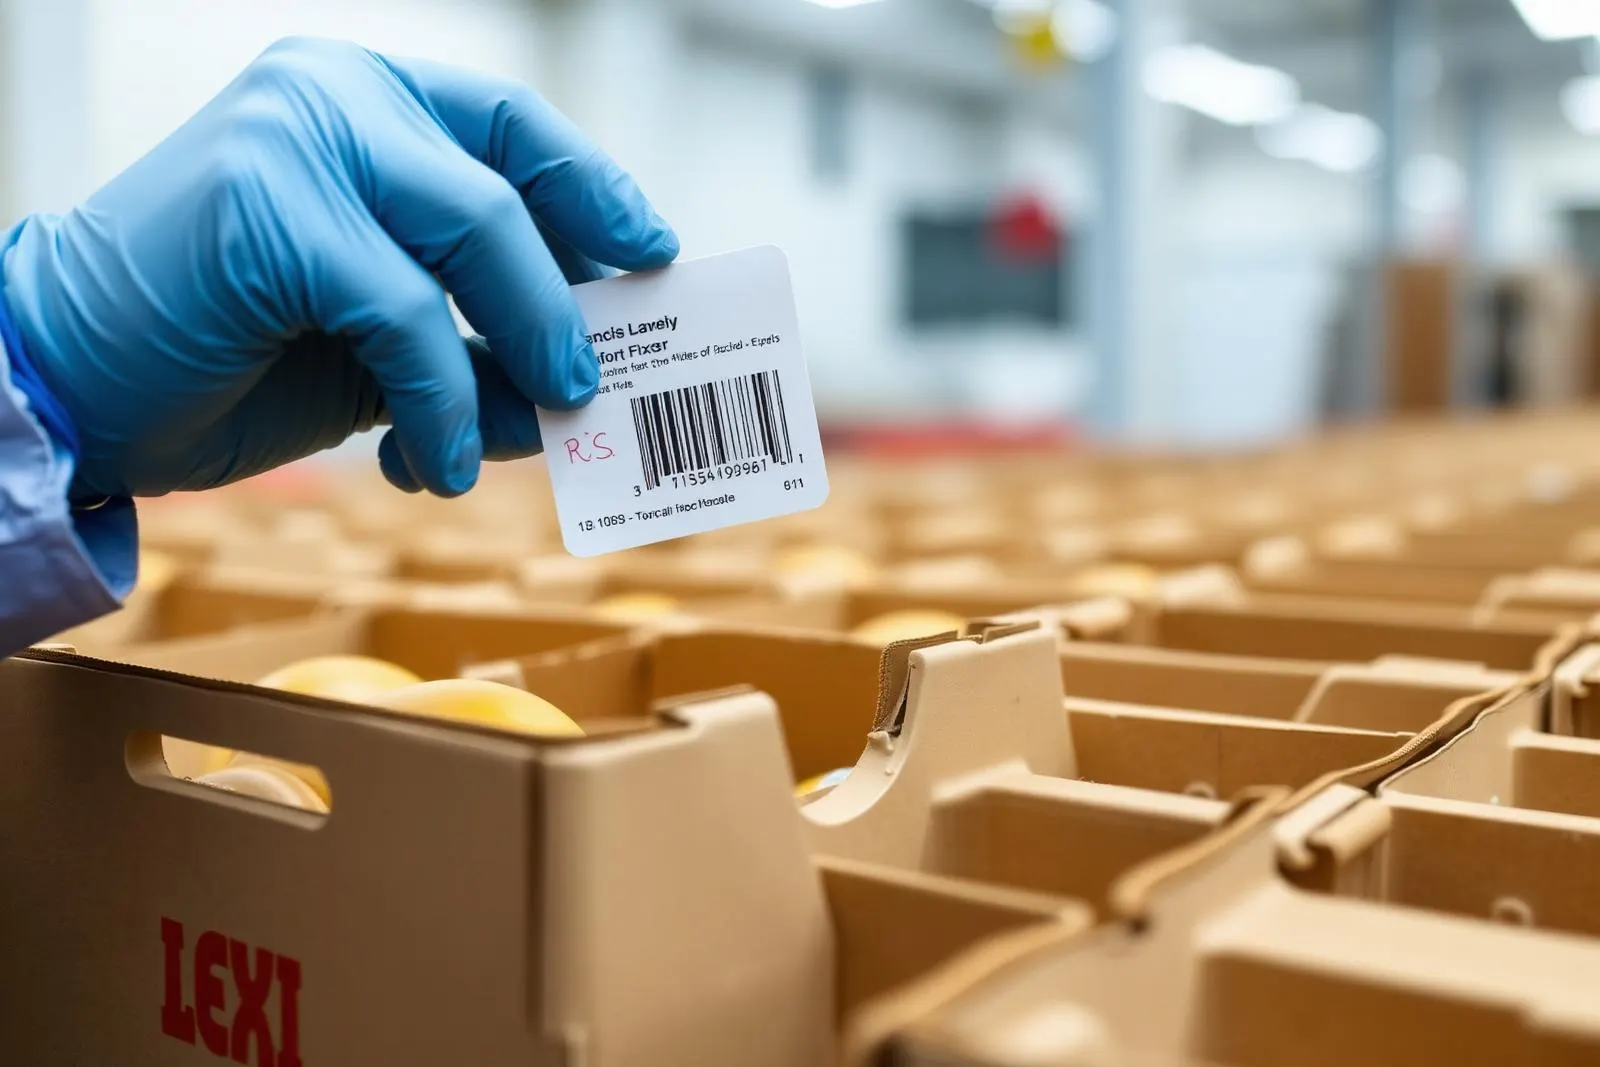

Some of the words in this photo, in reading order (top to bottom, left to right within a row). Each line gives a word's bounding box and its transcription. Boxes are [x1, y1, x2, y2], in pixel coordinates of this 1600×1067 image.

[596, 348, 626, 365] fort
[700, 345, 711, 358] of
[633, 485, 642, 497] 3
[160, 915, 304, 1067] LEXI
